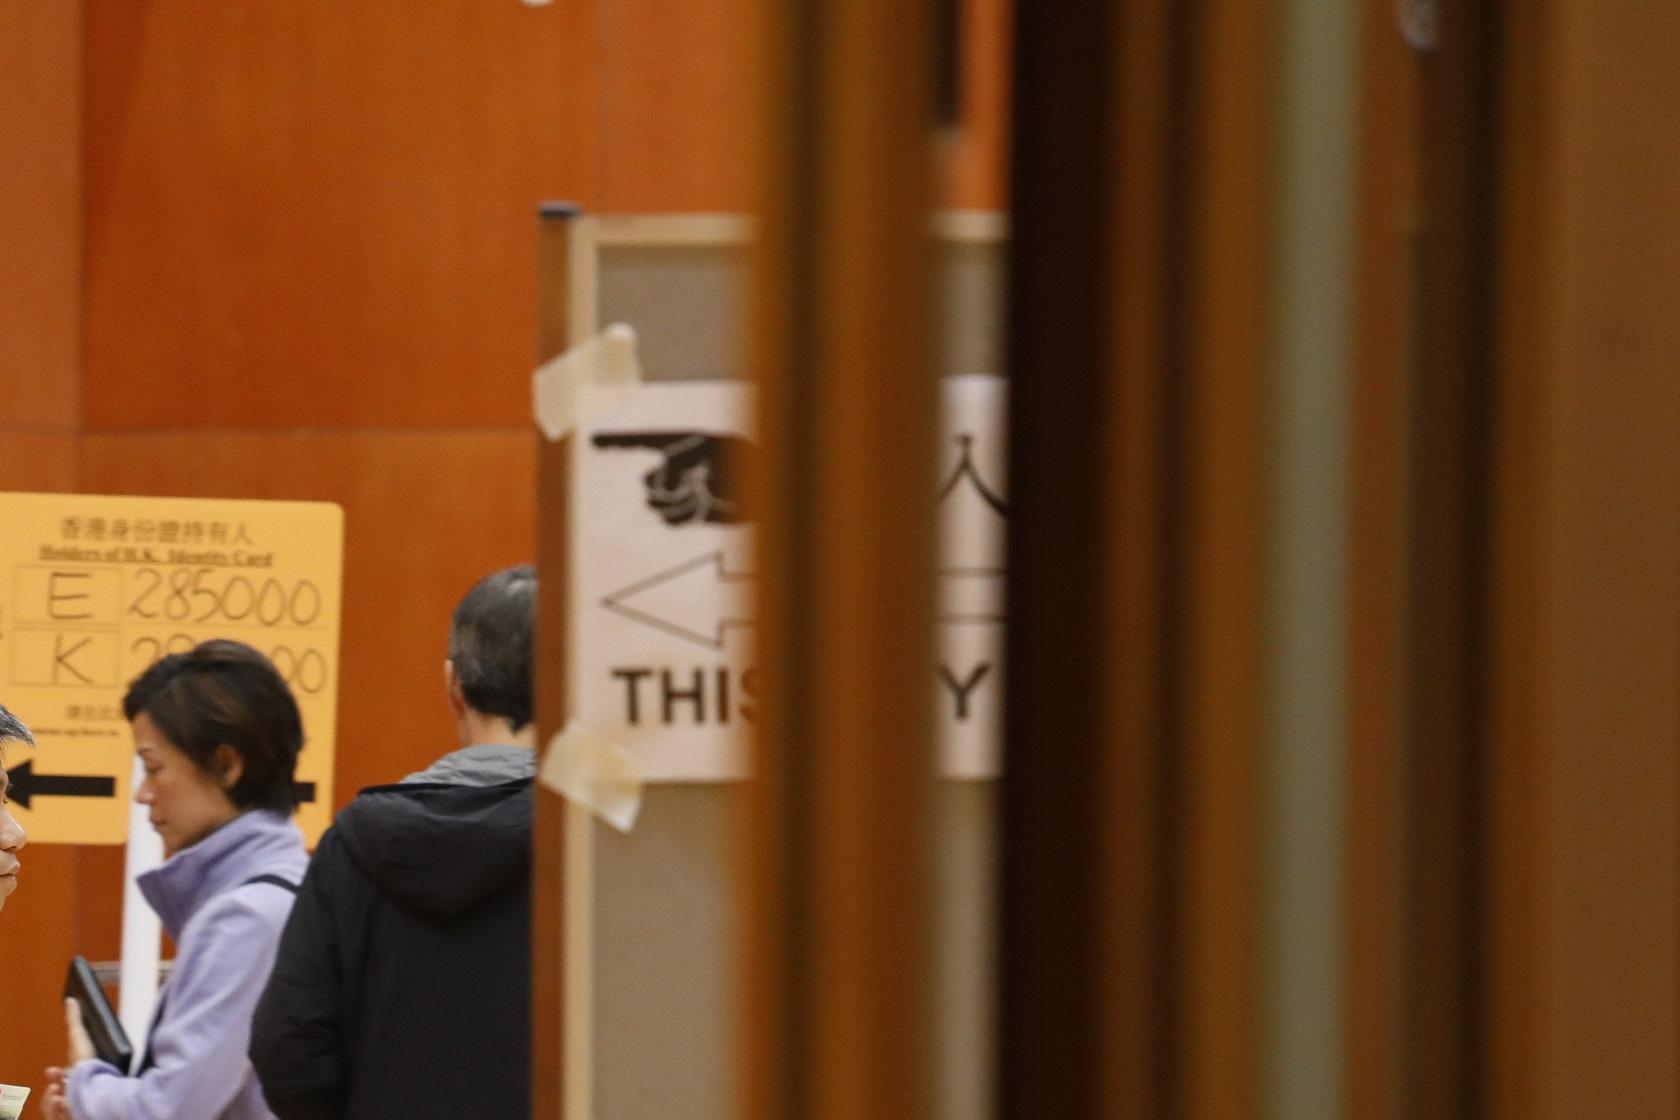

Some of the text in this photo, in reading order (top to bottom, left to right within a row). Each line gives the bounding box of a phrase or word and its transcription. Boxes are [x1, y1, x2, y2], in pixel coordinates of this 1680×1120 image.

[47, 567, 321, 626] E 285000
[52, 634, 94, 686] K
